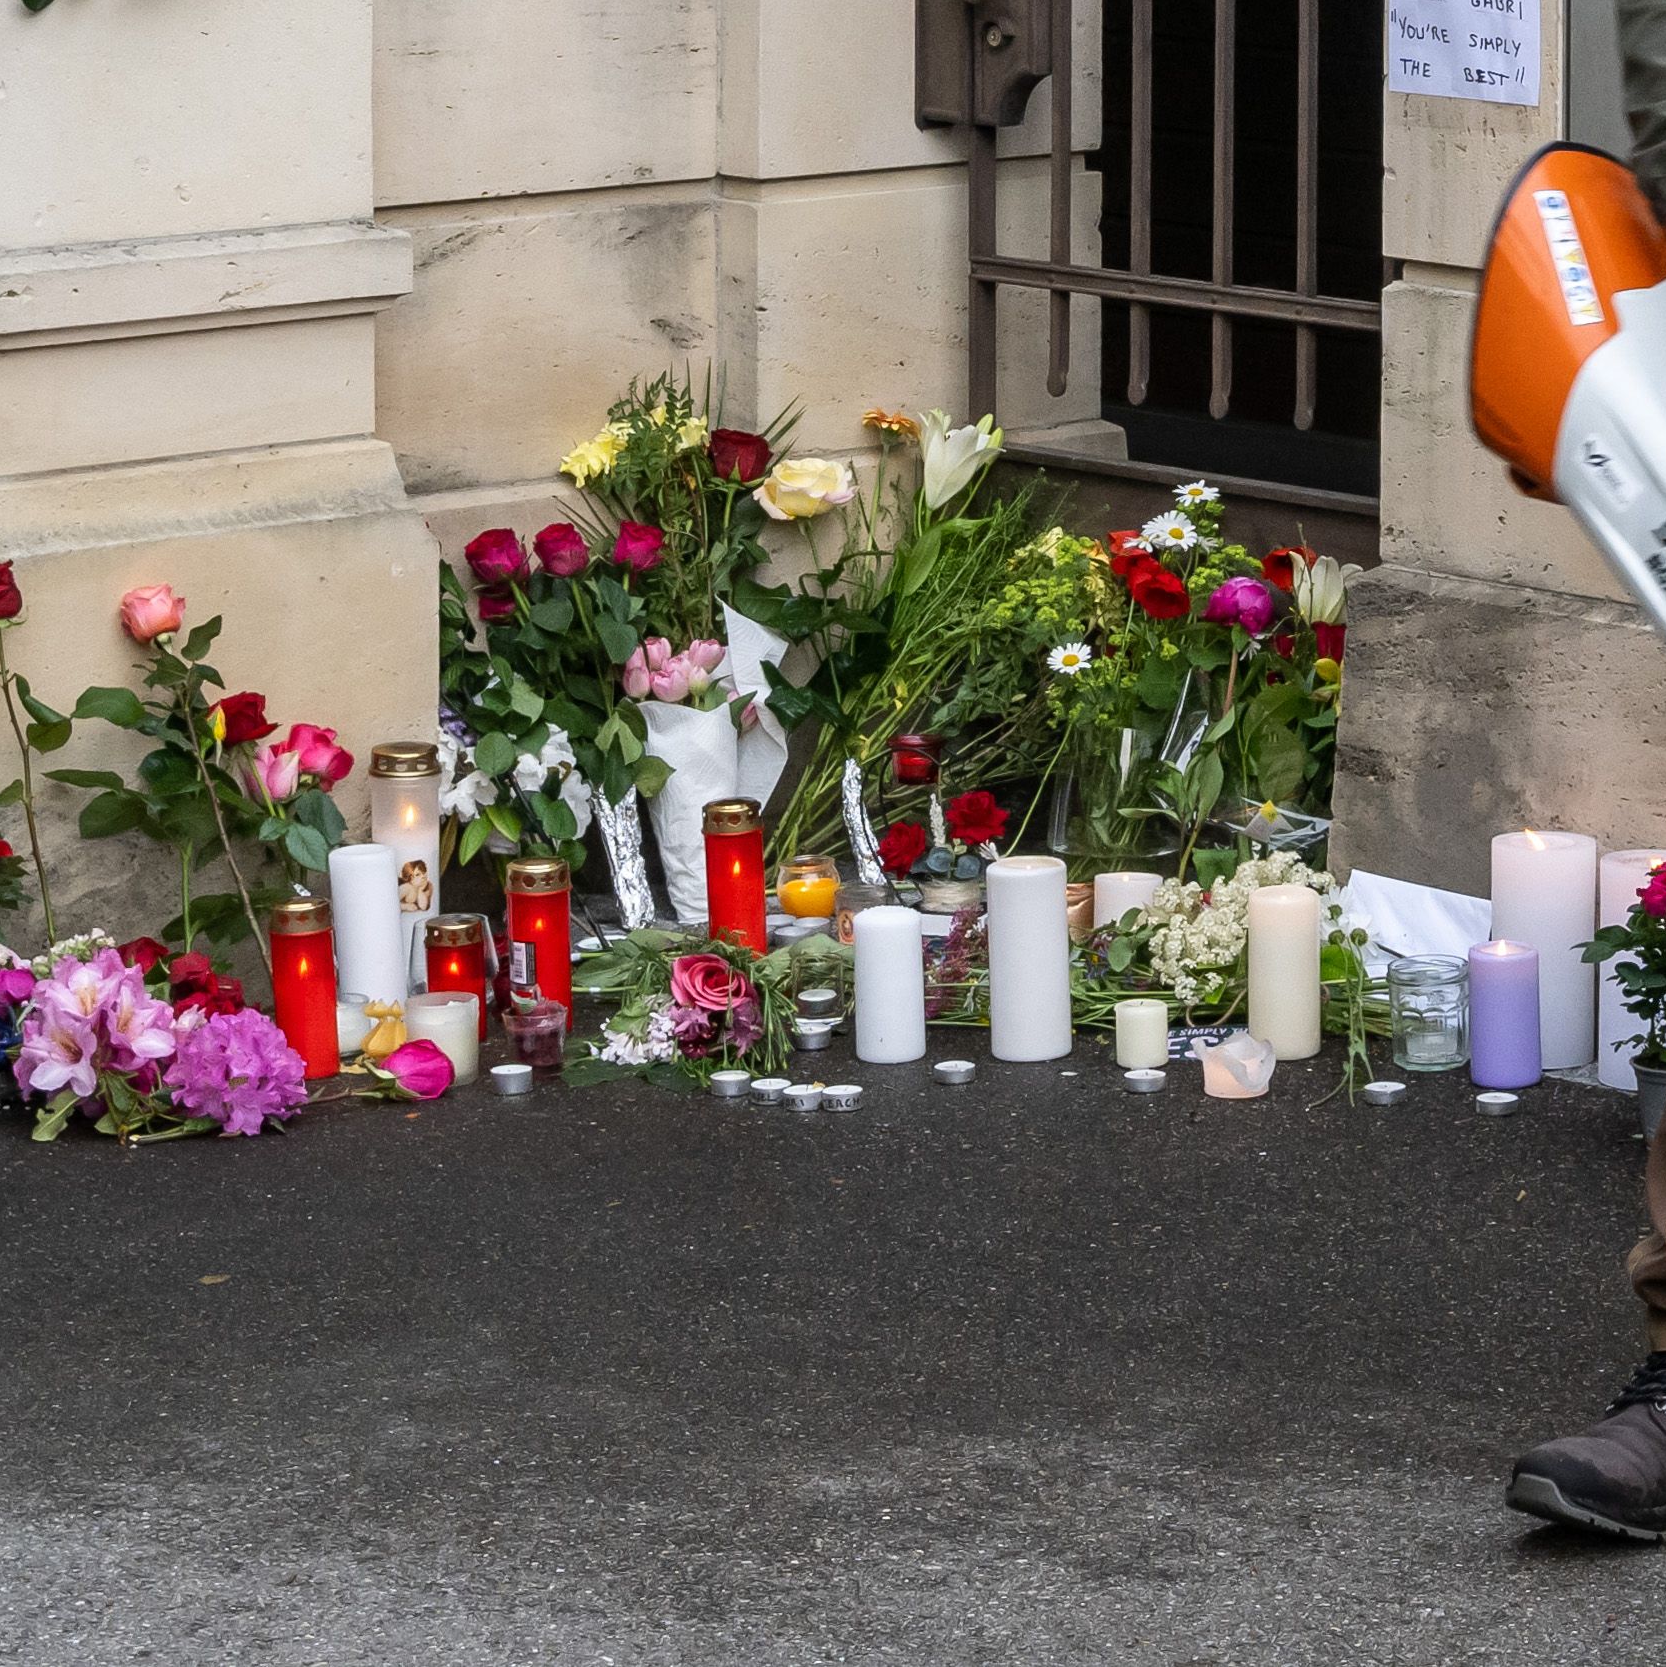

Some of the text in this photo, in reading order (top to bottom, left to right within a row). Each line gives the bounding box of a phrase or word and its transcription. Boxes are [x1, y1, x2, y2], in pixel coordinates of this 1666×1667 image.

[1469, 34, 1521, 57] SIMPLY
[1399, 58, 1432, 78] THE
[1179, 1028, 1227, 1036] SIMPLY
